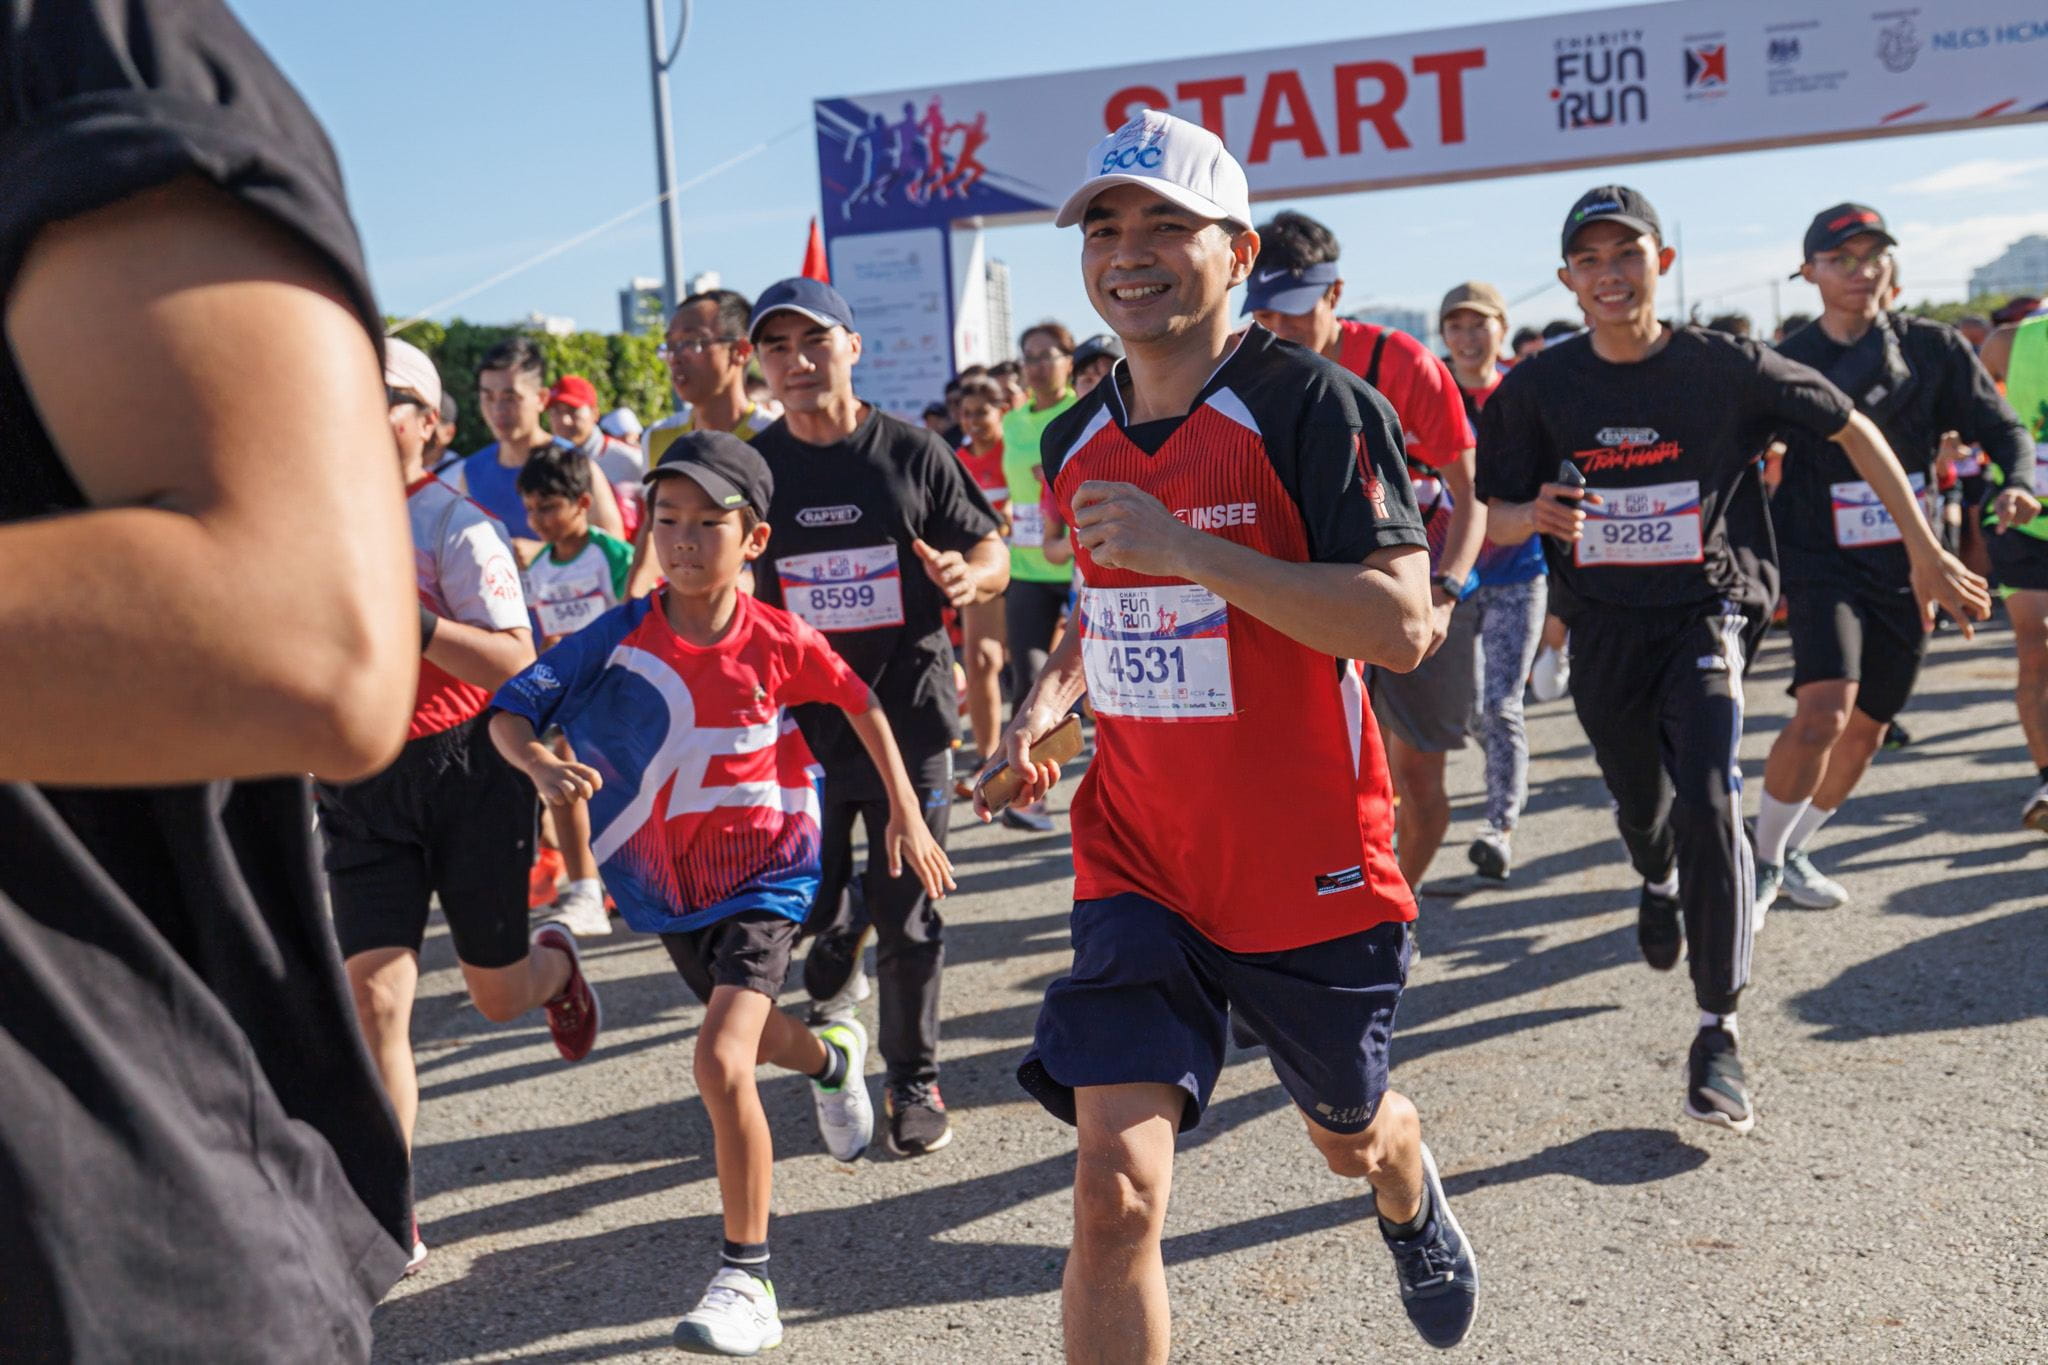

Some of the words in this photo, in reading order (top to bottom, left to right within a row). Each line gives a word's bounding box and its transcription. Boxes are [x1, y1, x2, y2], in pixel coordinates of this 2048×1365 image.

[1557, 47, 1646, 86] FUN
[1558, 86, 1648, 130] RUN
[1191, 502, 1257, 530] INSEE
[1602, 521, 1673, 544] 9282
[810, 584, 875, 610] 8599
[1120, 598, 1150, 612] FUN
[1122, 613, 1150, 629] RUN
[1108, 645, 1186, 684] 4531
